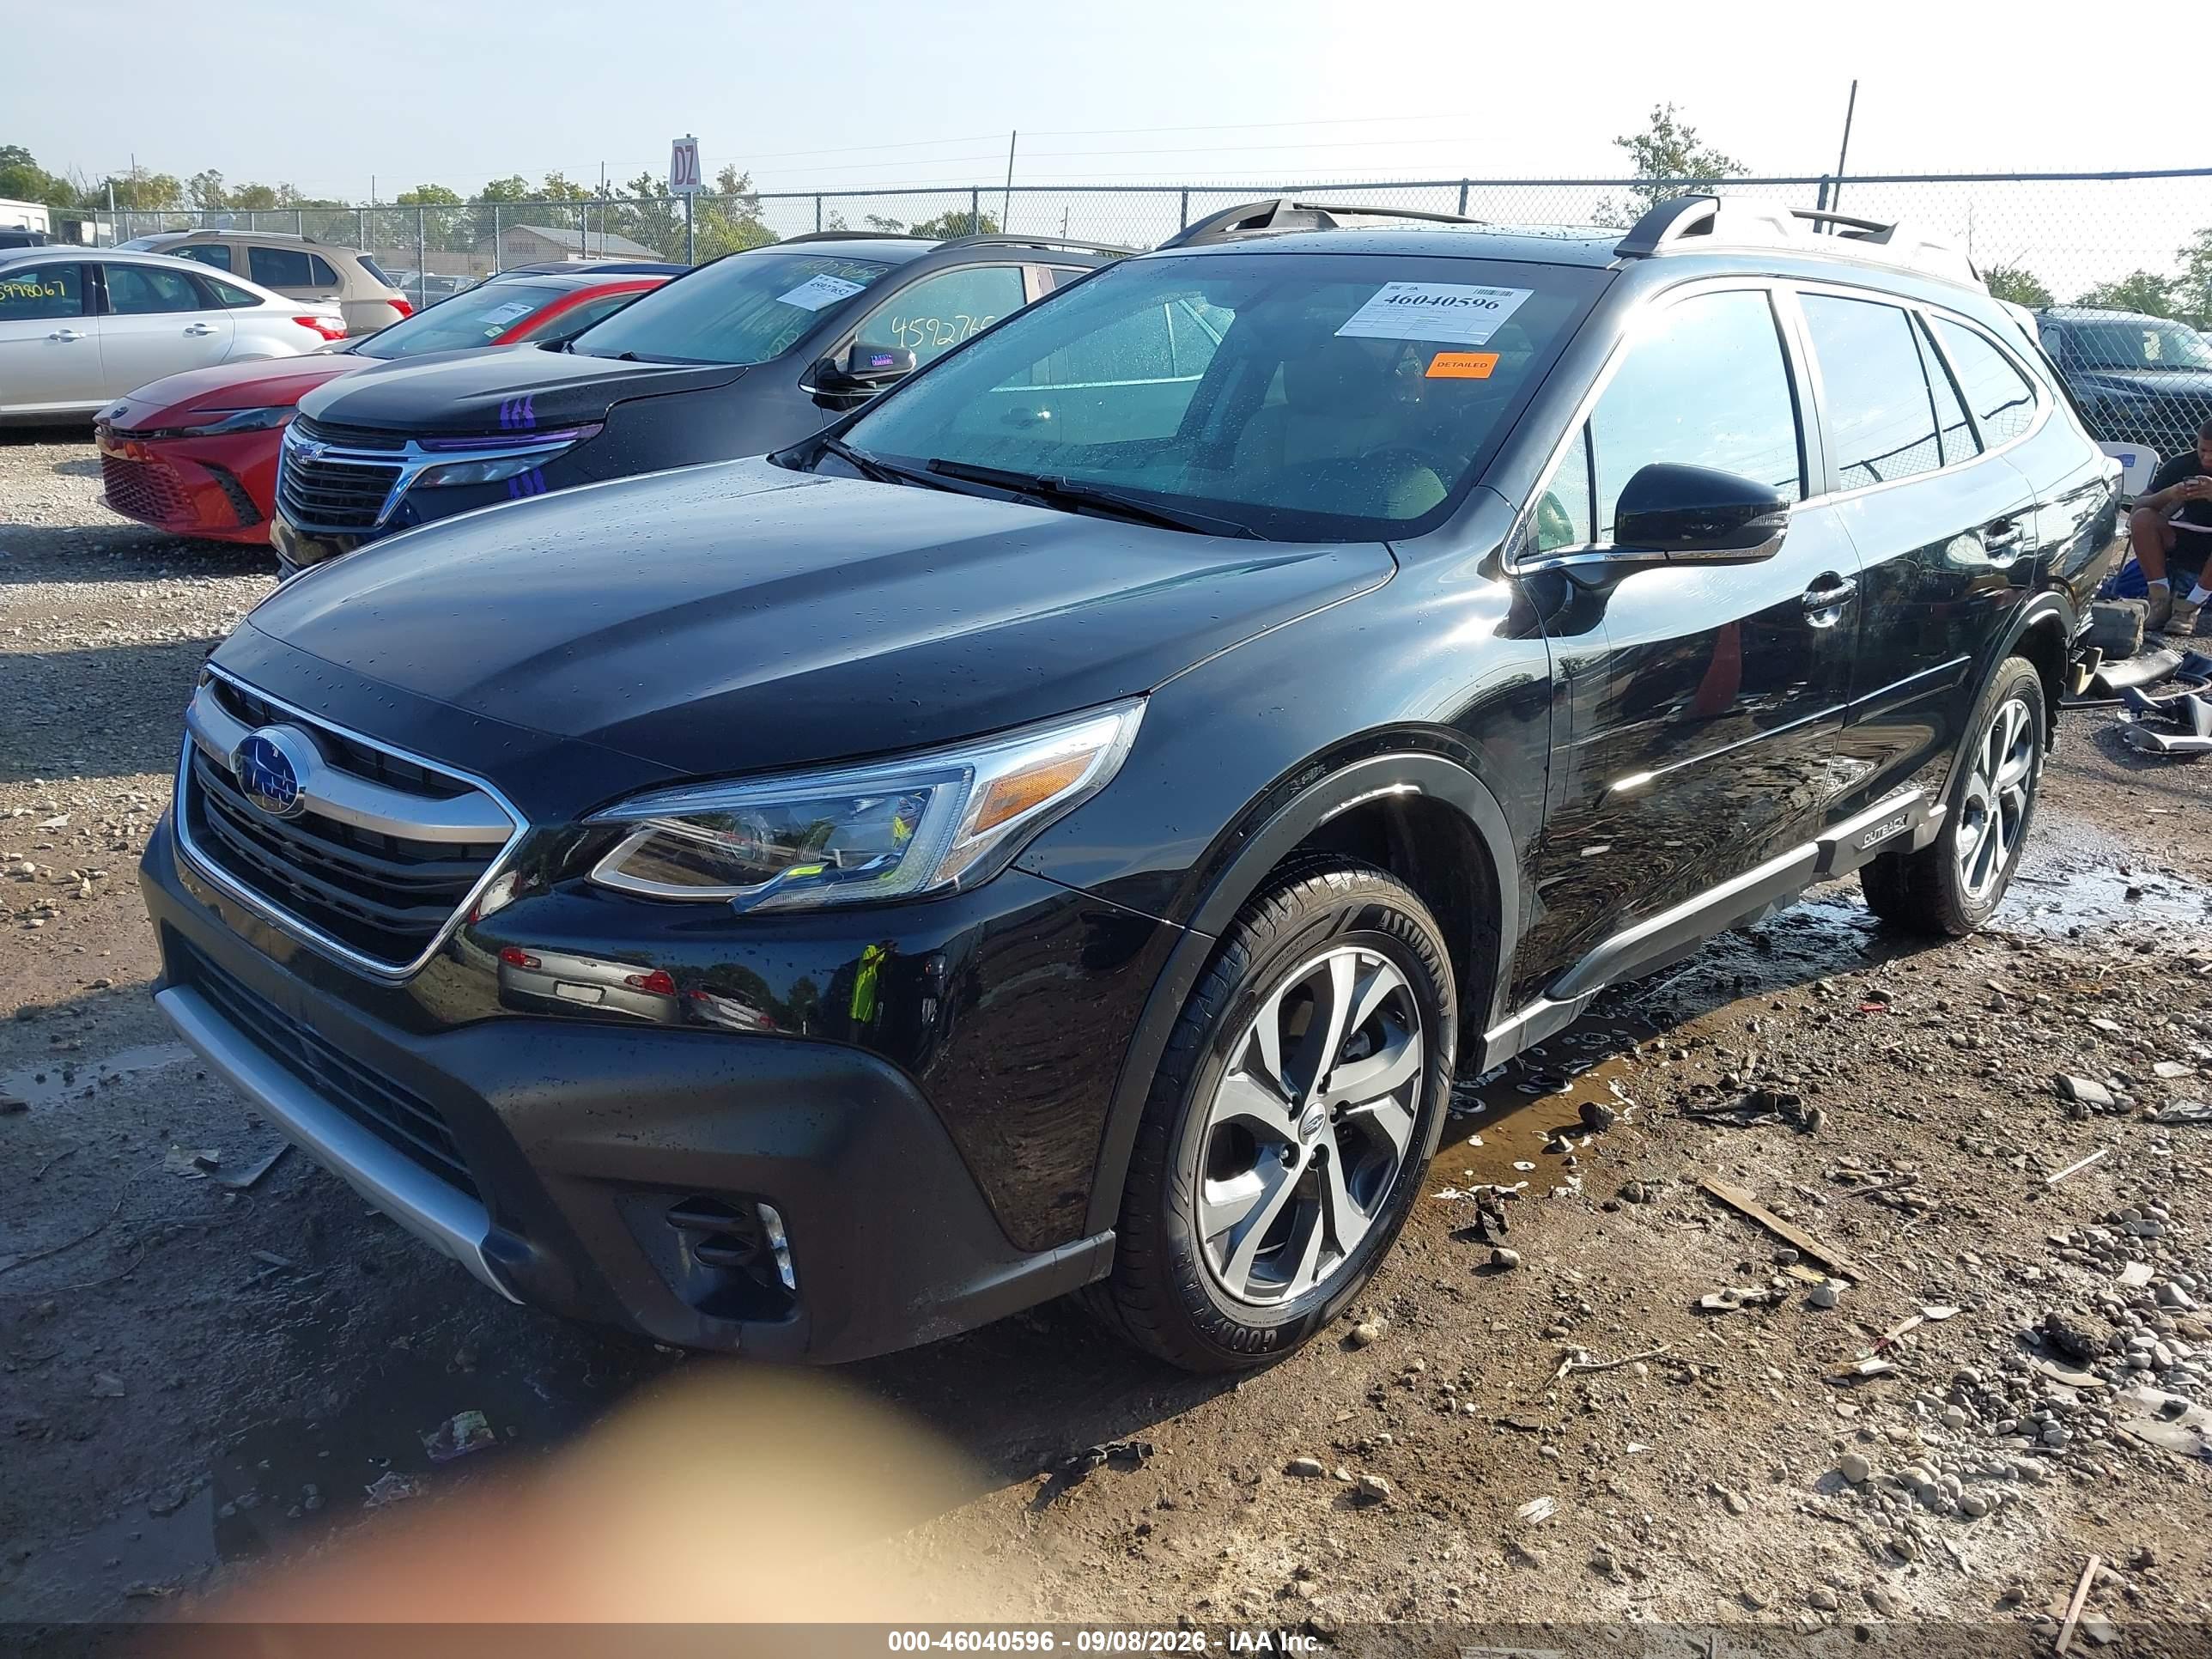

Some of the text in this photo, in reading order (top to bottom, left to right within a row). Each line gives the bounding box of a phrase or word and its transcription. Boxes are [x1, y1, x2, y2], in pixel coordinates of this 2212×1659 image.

[1383, 294, 1501, 311] 46040596
[1437, 361, 1488, 369] DETAILED
[1864, 815, 1907, 844] OUTBACK
